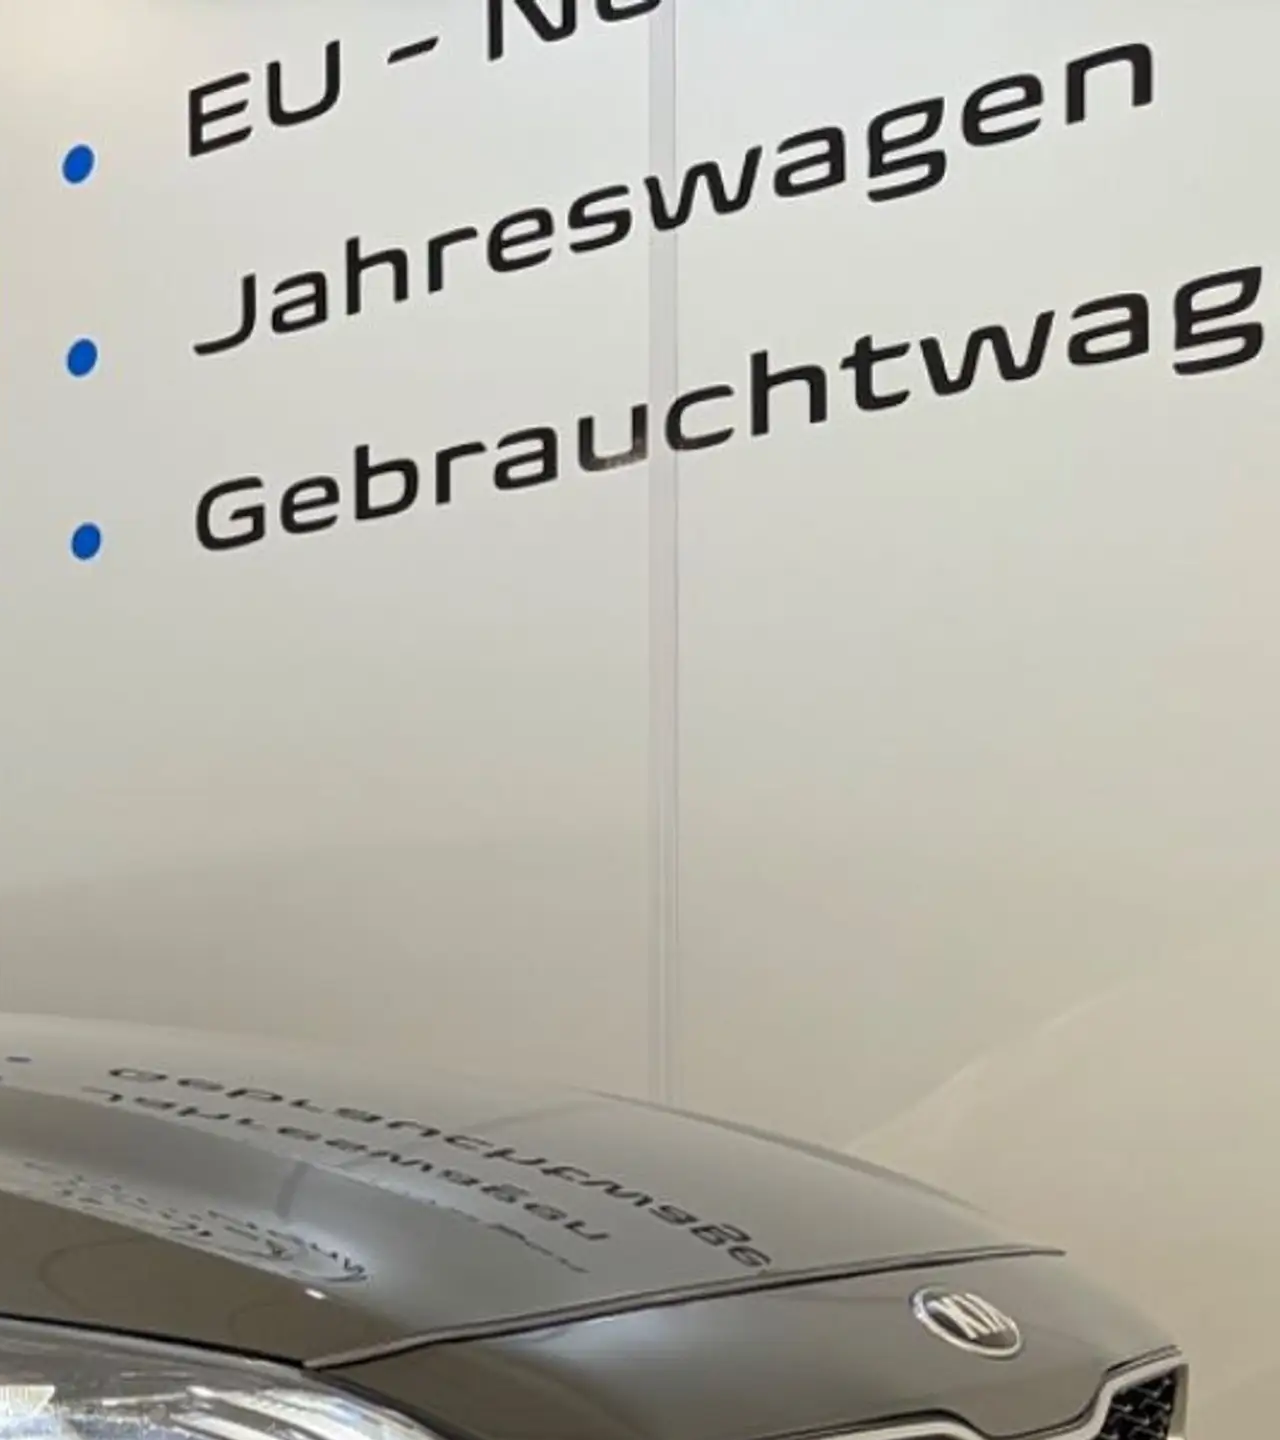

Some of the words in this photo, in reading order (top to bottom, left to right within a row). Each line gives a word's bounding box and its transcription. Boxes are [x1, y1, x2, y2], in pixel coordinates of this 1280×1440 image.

[186, 38, 342, 158] EU
[191, 42, 1154, 357] Jahreswagen
[194, 265, 1265, 553] Gebrauchtwag
